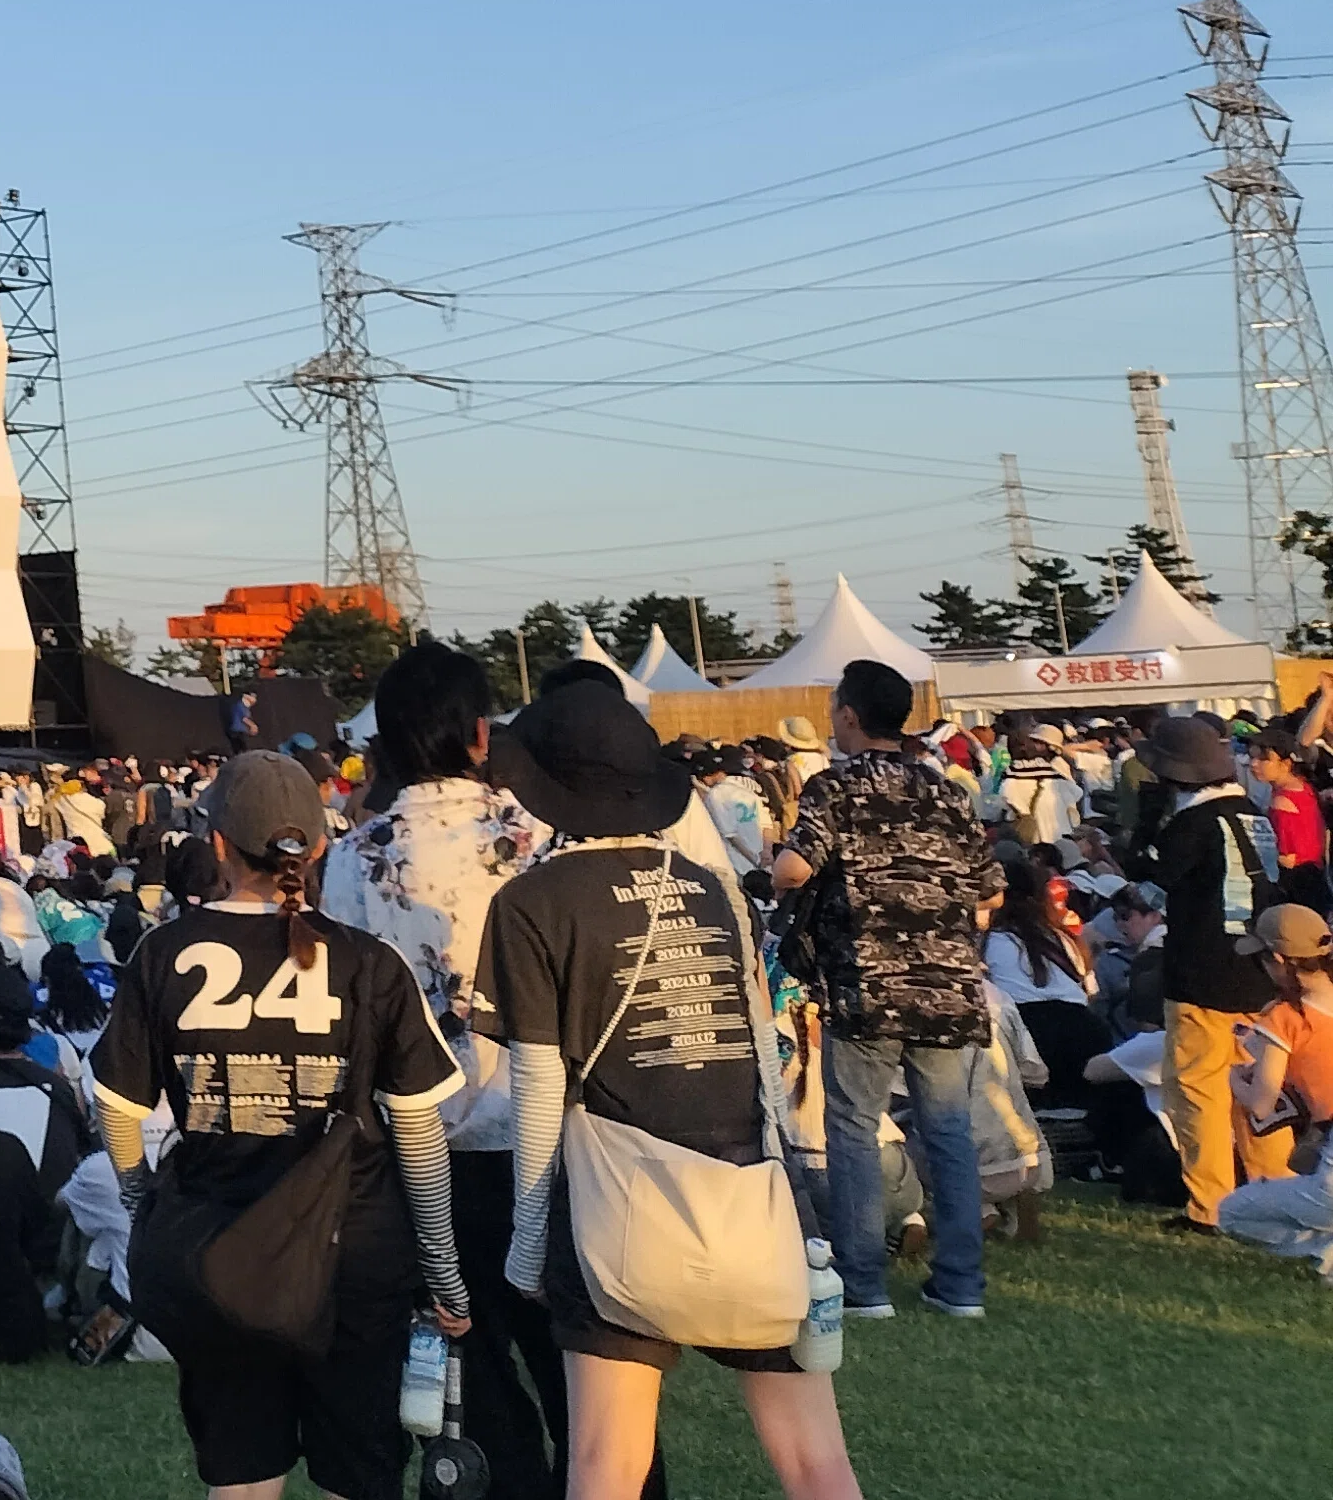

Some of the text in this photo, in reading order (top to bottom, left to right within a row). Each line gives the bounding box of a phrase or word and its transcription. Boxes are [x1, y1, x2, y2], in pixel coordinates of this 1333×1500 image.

[1066, 657, 1163, 685] 救護受付
[174, 941, 342, 1034] 24
